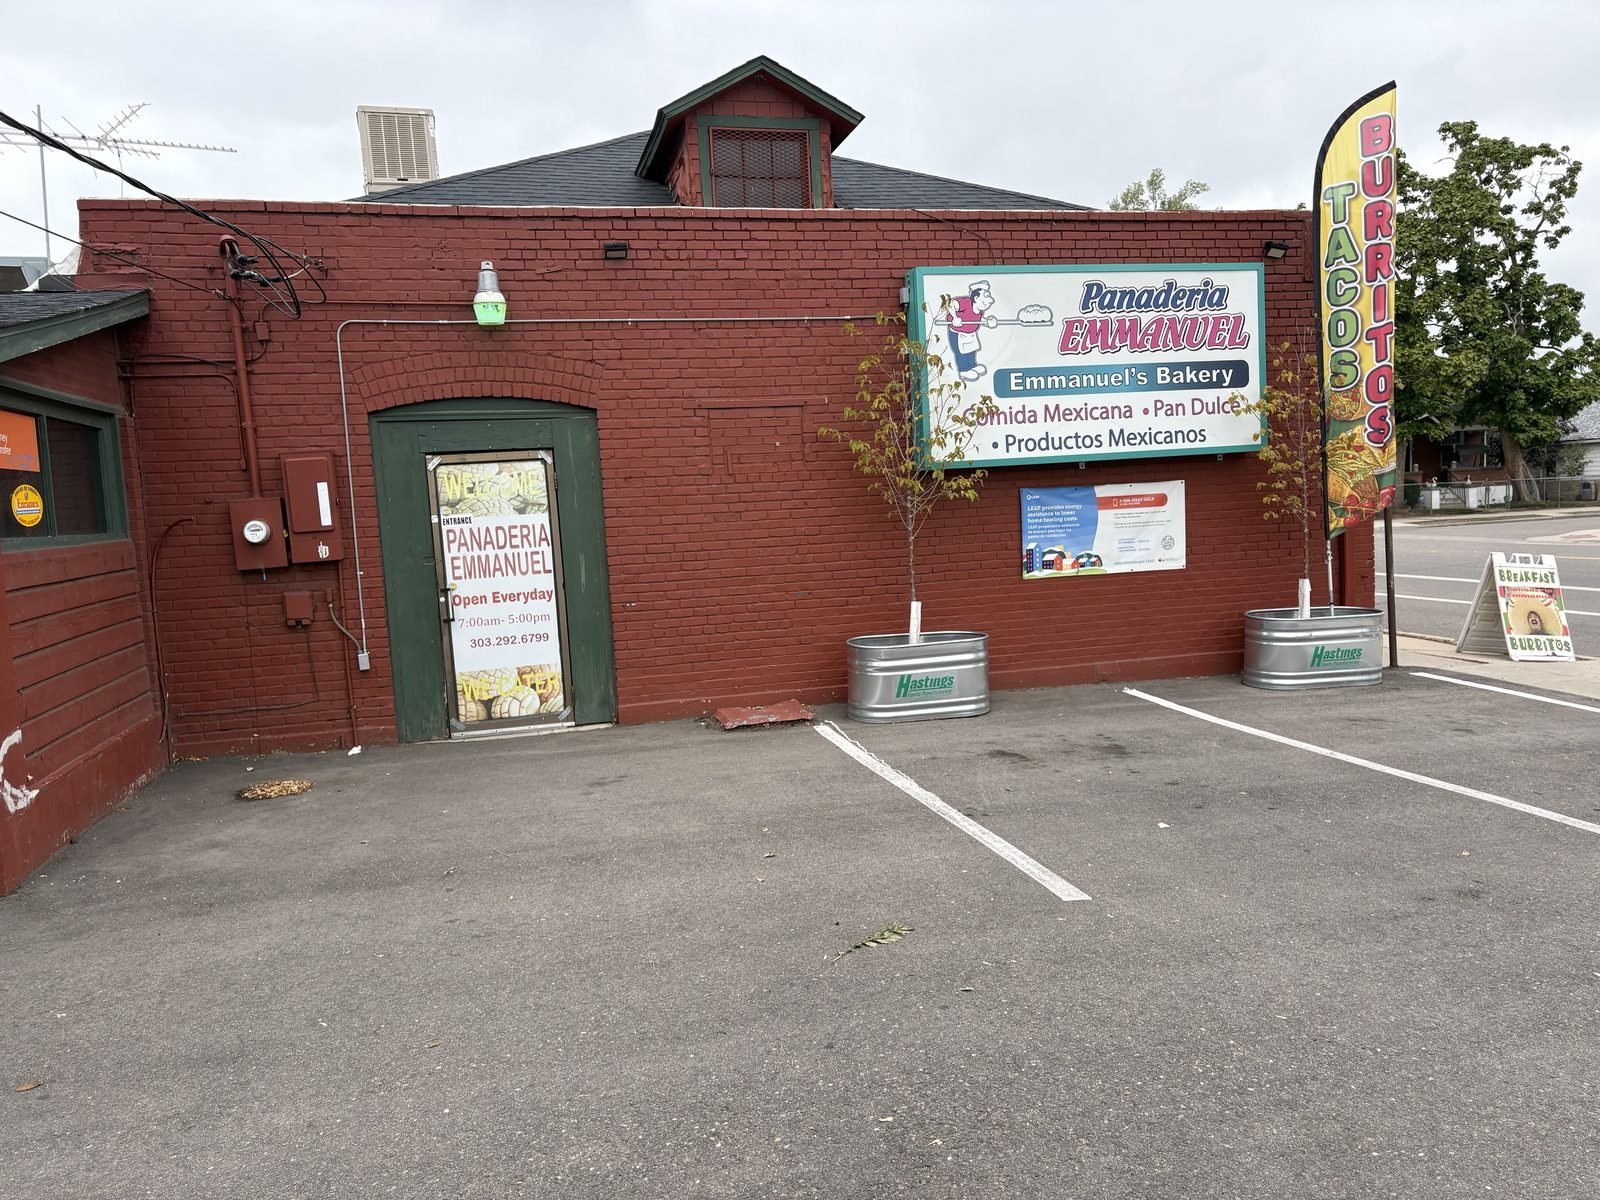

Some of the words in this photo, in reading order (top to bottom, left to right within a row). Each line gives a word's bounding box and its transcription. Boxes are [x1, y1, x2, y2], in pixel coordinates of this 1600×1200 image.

[1324, 181, 1361, 391] TACOS
[1360, 113, 1396, 447] BURRITOS
[1080, 278, 1229, 313] Panaderia
[1058, 313, 1250, 356] EMMANUEL
[1009, 368, 1149, 391] Emmanuel's
[1156, 366, 1233, 387] Bakery
[1043, 404, 1133, 424] Mexicana
[1153, 400, 1186, 418] Pan
[1190, 396, 1241, 416] Dulce
[1005, 430, 1103, 453] Productos
[1108, 427, 1207, 447] Mexicanos
[444, 470, 538, 500] WELCOME
[442, 516, 473, 526] ENTRANCE
[446, 522, 550, 553] PANADERIA
[450, 550, 552, 581] EMMANUEL
[1498, 569, 1556, 584] BREAKFAST
[451, 594, 488, 609] Open
[491, 588, 554, 606] Everyday
[508, 611, 551, 626] 5:00pm
[470, 632, 550, 649] 303.292.6799
[1509, 636, 1571, 652] BURRITOS
[1311, 645, 1362, 667] Hastings
[461, 678, 494, 702] WE
[499, 671, 560, 699] CATER
[896, 674, 954, 698] Hastings
